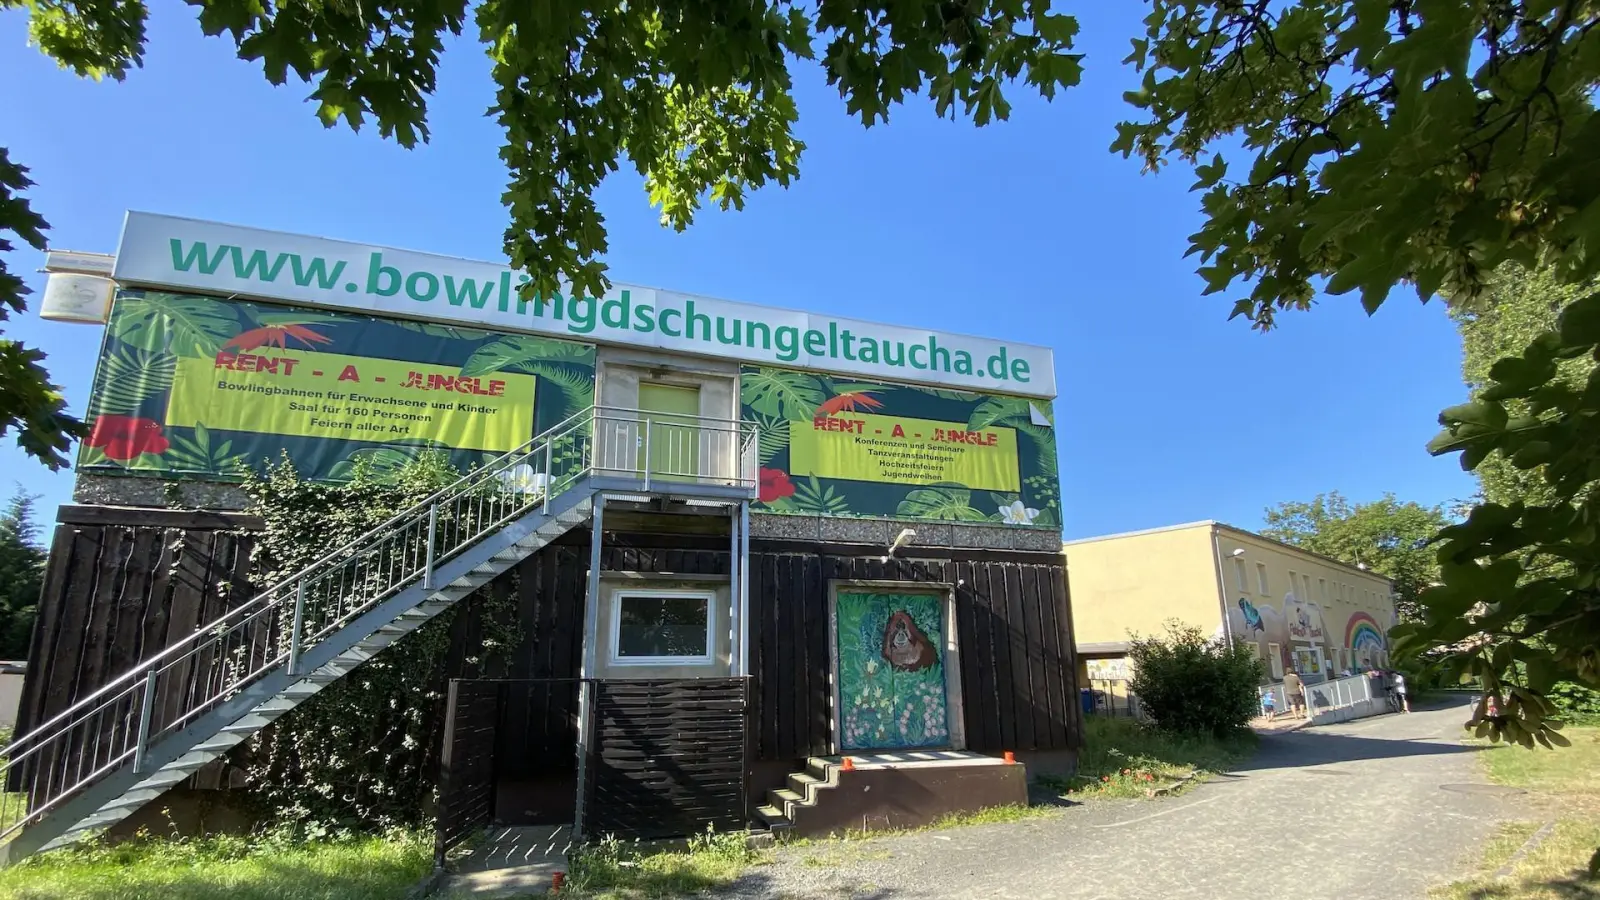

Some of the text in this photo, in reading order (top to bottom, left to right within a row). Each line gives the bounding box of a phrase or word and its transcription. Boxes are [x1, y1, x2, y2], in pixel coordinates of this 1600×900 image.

[215, 352, 299, 375] RENT
[337, 364, 360, 383] A
[400, 372, 506, 396] JUNGLE
[218, 381, 498, 415] Bowlingbahnen für Erwachsene und Kinder
[289, 402, 433, 423] Saal für 160 Personen
[310, 418, 410, 435] Feiern aller Art
[813, 417, 865, 434] RENT
[891, 424, 906, 439] A
[931, 428, 997, 446] JUNGLE
[855, 436, 965, 454] Konferenzen und Seminare
[868, 448, 954, 463] Tanzveranstaltungen
[880, 460, 944, 472] Hochzeitsfeiern
[882, 470, 942, 481] Jugendweihen
